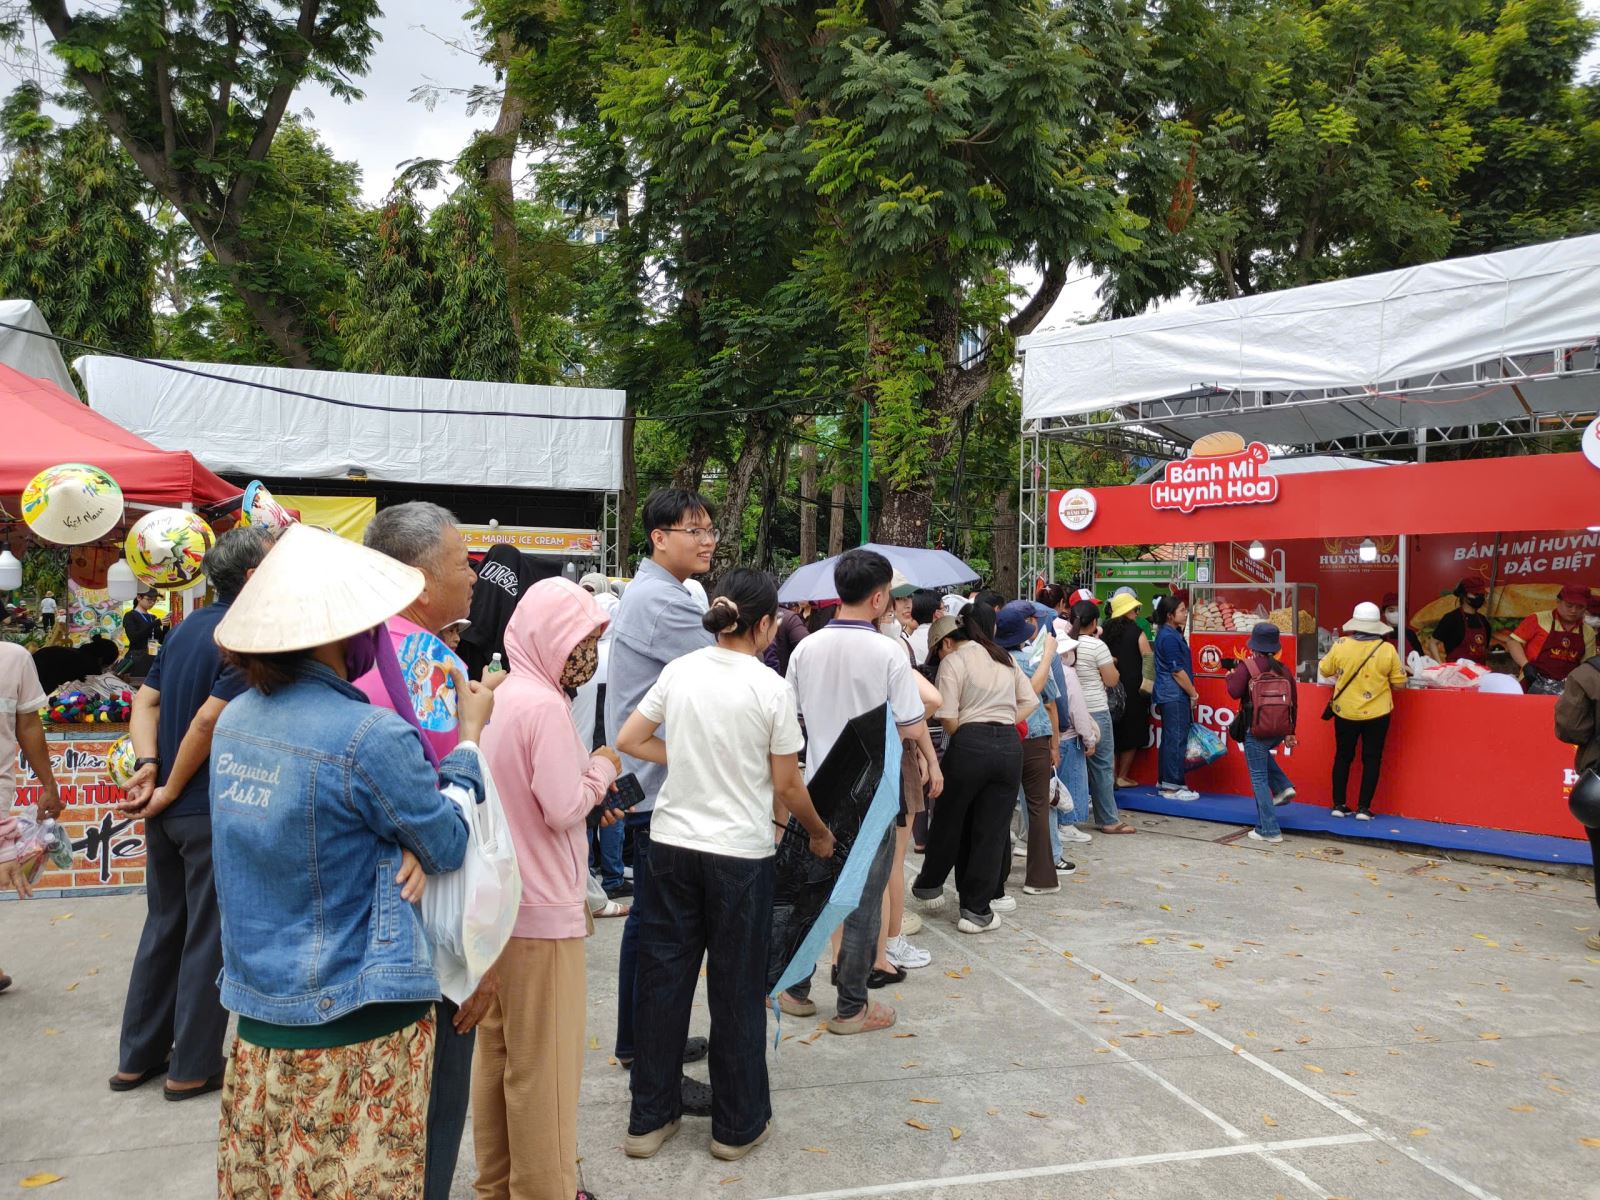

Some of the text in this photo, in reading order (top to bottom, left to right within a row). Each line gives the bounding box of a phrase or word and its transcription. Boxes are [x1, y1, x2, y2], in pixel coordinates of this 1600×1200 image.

[1171, 458, 1253, 483] Bánh Mì
[1156, 480, 1270, 506] Huynh Hoa
[482, 535, 516, 544] MARIUS
[519, 536, 531, 544] ICE
[535, 537, 564, 545] CREAM
[1539, 533, 1600, 552] HUYN
[1320, 555, 1361, 564] HUYN
[1552, 551, 1595, 571] BIỆT
[14, 780, 128, 806] XUN TÙN
